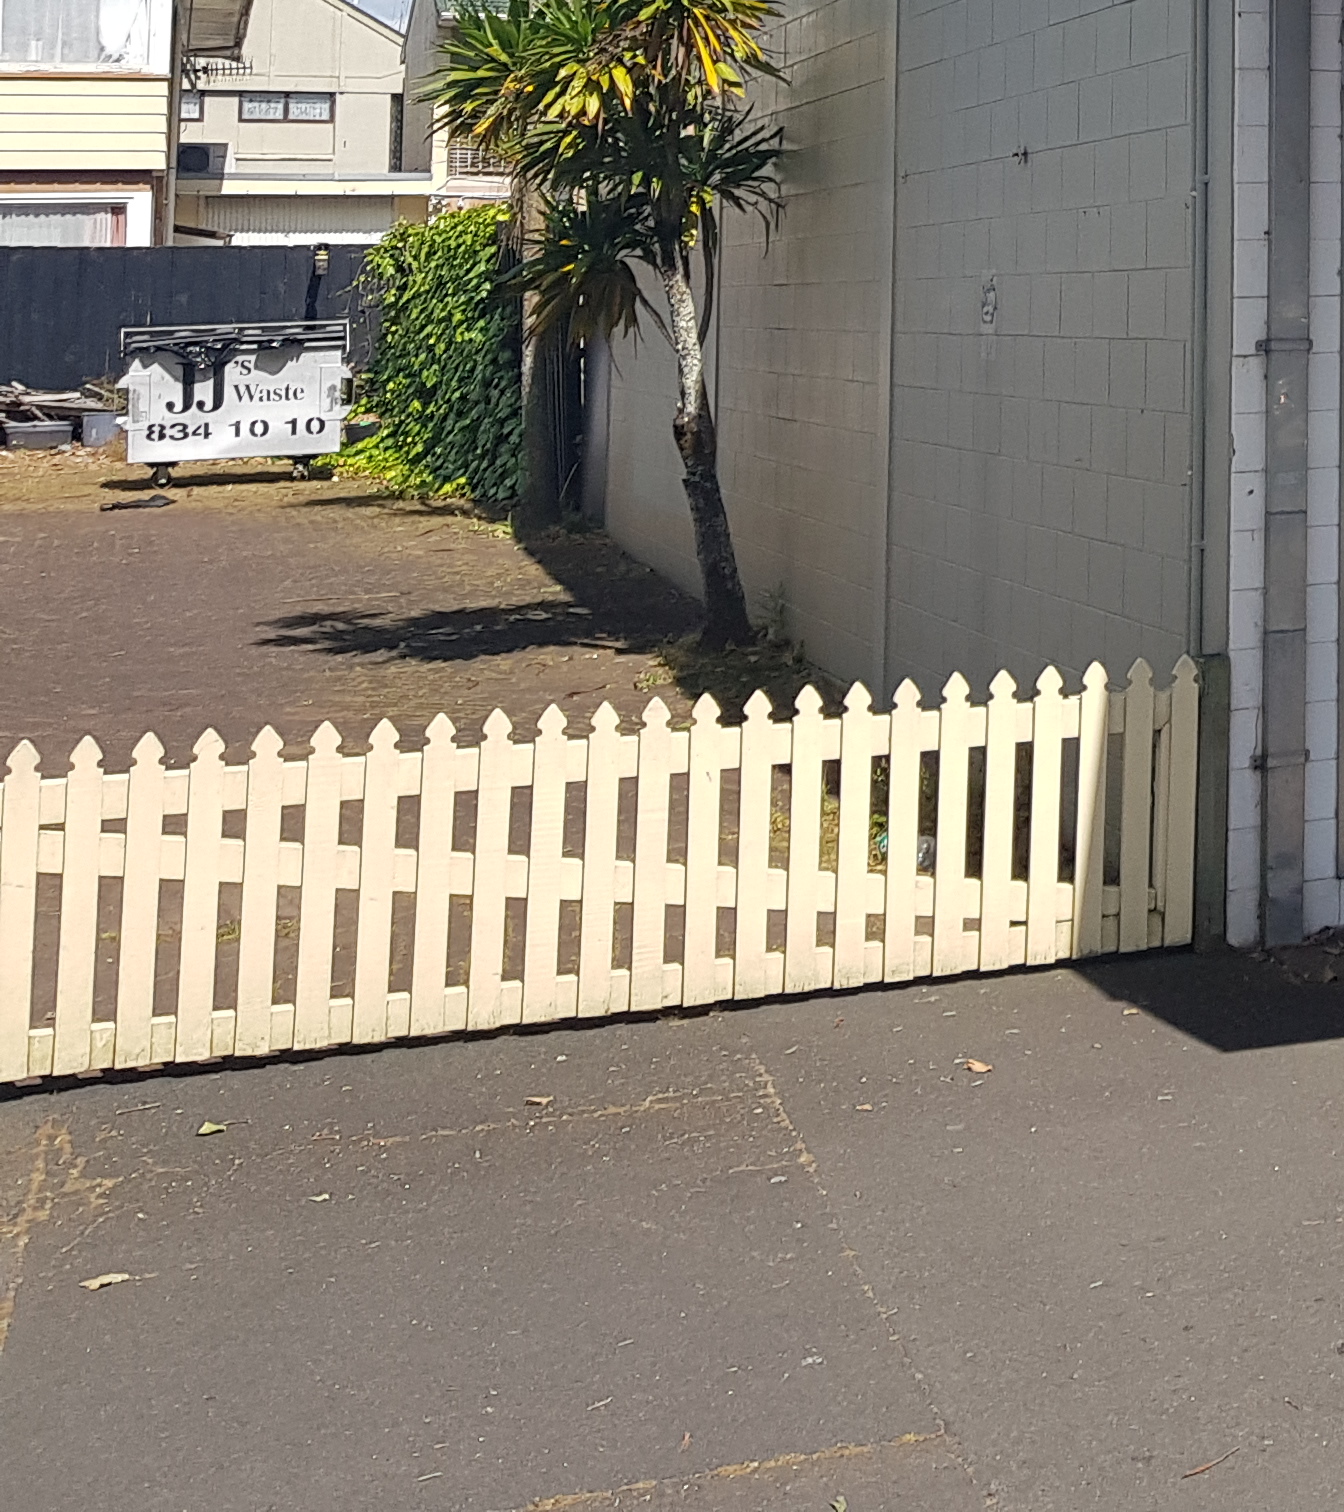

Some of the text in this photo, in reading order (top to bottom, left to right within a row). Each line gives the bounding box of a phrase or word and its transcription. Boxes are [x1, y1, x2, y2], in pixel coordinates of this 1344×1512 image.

[233, 383, 305, 402] Waste
[145, 417, 326, 442] 834 10 10
